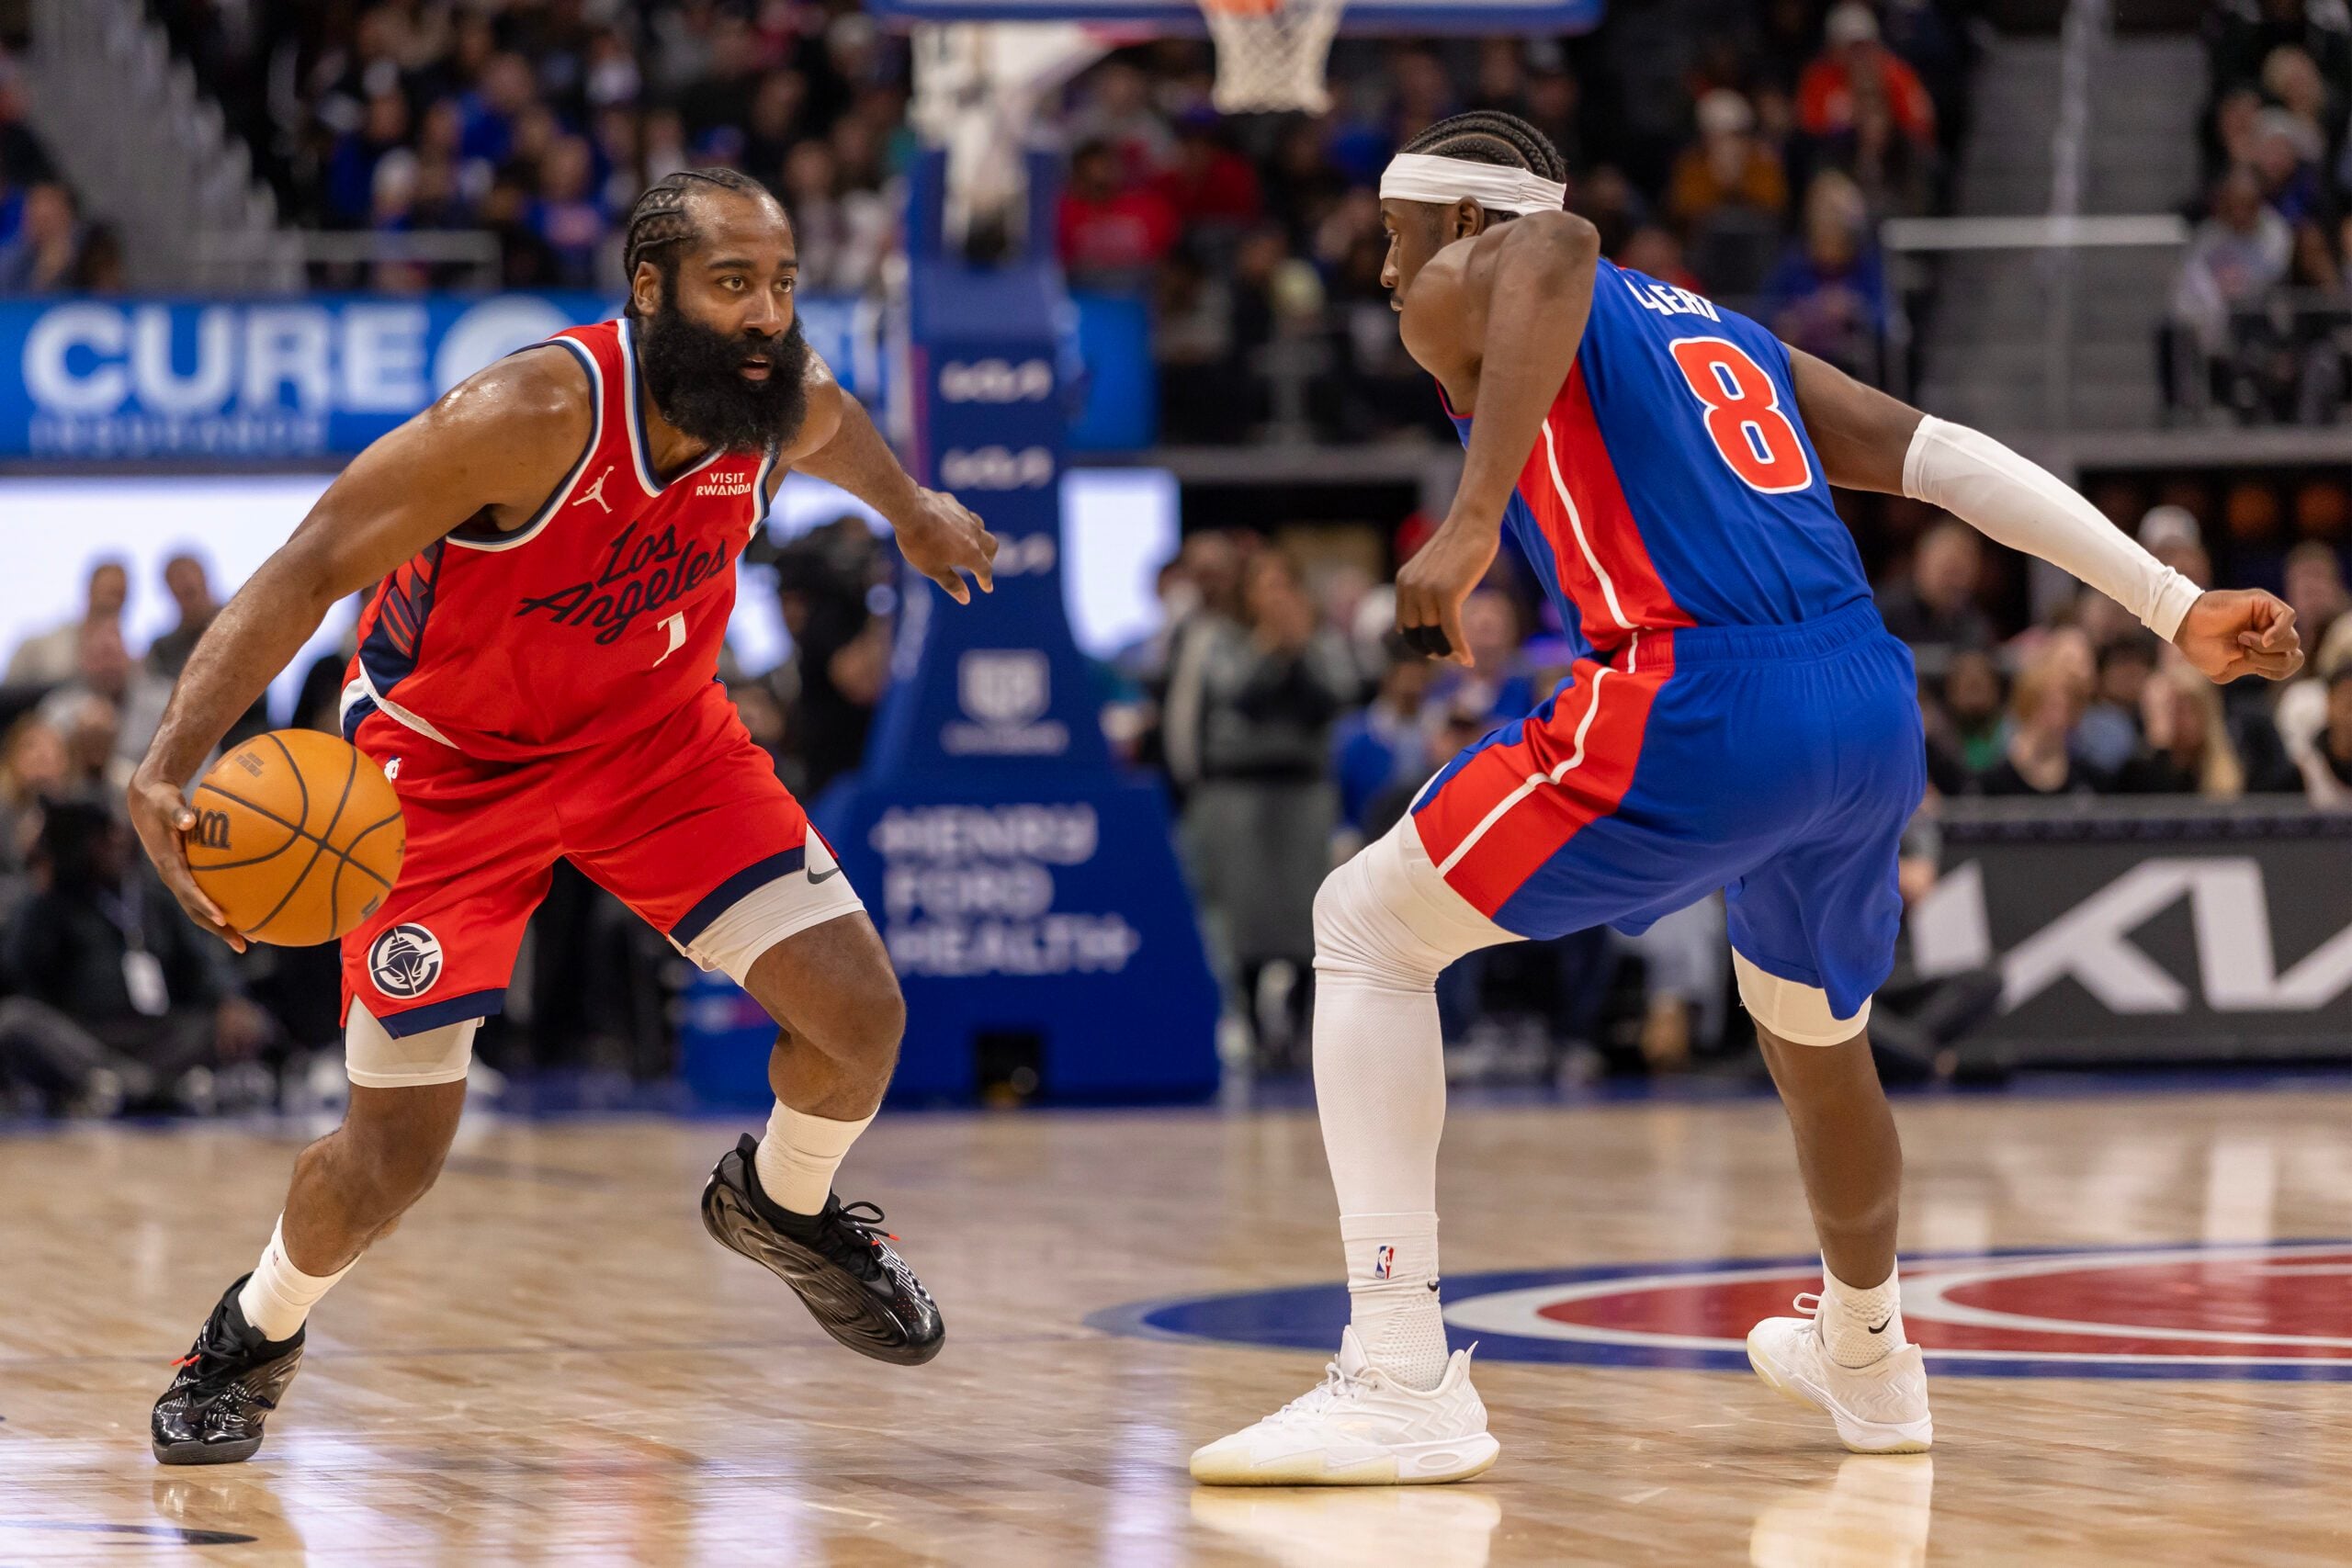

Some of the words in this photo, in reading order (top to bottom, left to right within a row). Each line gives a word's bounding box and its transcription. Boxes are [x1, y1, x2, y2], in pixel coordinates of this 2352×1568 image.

[22, 301, 429, 417] CURE
[1668, 336, 1813, 494] 8
[695, 482, 752, 496] RWANDA
[709, 472, 745, 484] VISIT
[514, 538, 729, 646] Angeles
[597, 520, 681, 586] Los
